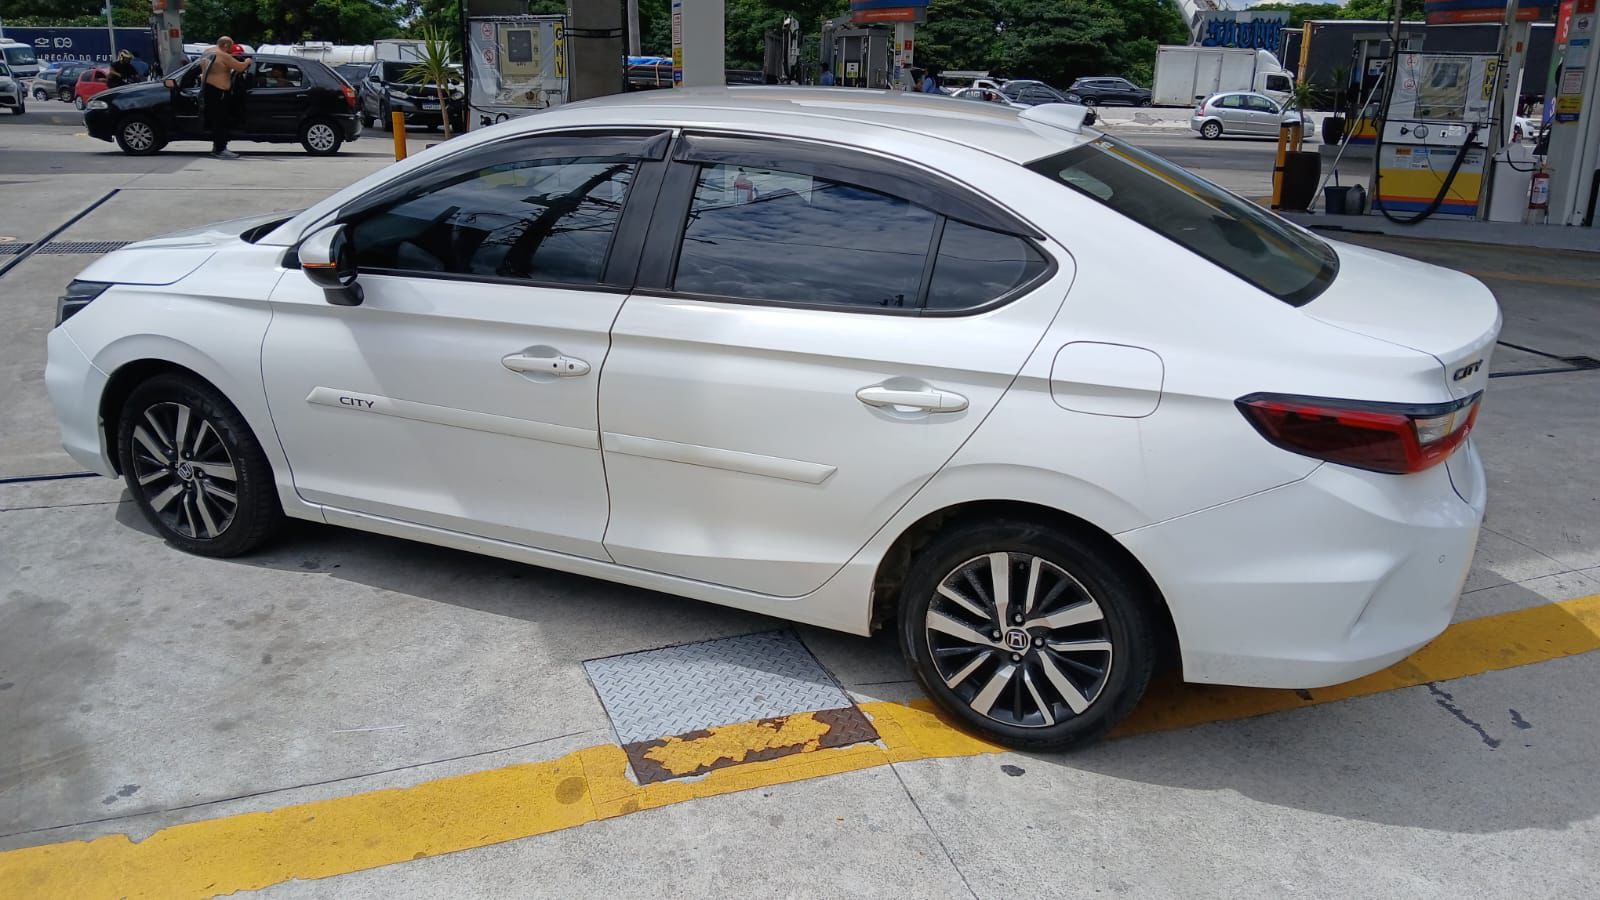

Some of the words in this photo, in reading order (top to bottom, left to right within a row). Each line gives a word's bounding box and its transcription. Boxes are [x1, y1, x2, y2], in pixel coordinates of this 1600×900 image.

[555, 27, 564, 74] GNV
[1484, 62, 1496, 97] GNV
[339, 396, 375, 408] CITY
